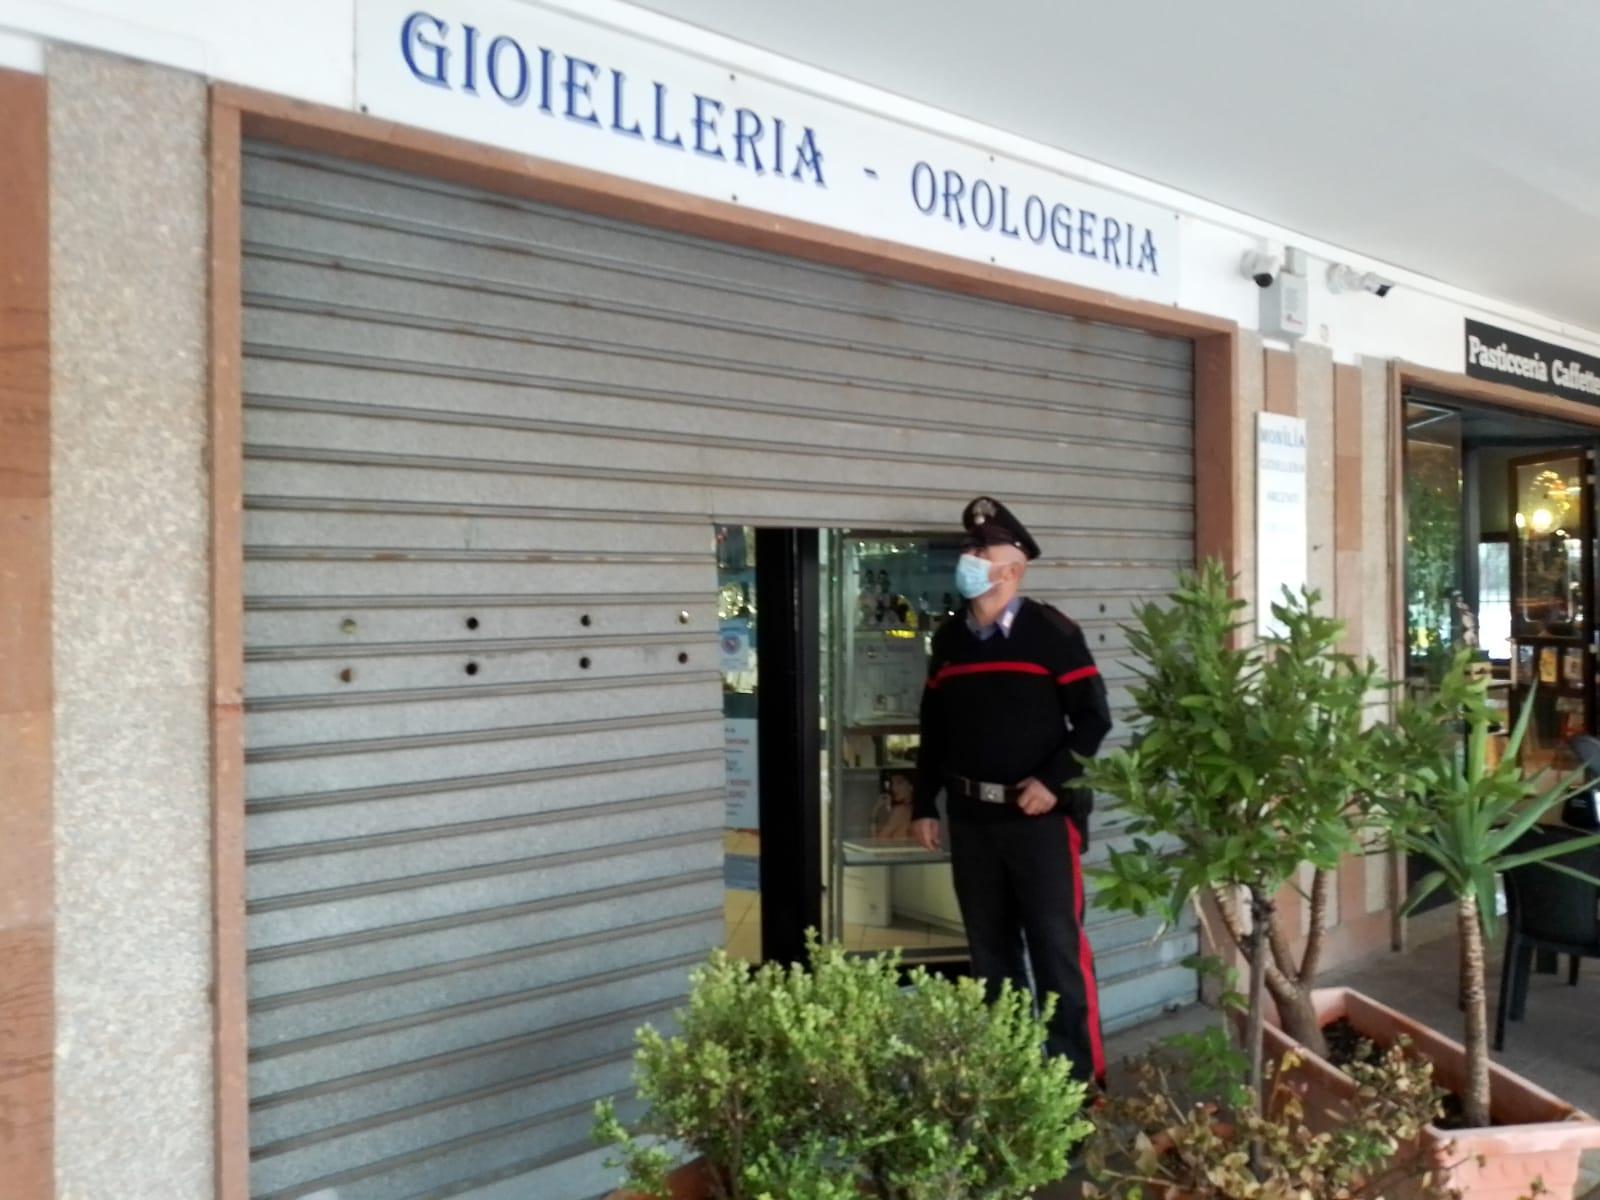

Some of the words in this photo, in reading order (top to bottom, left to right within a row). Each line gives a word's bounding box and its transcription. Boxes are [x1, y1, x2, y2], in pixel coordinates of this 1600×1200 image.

[400, 11, 827, 188] GIOIELLERIA
[911, 160, 1160, 276] OROLOGERIA
[1468, 335, 1549, 382] Pasticceria
